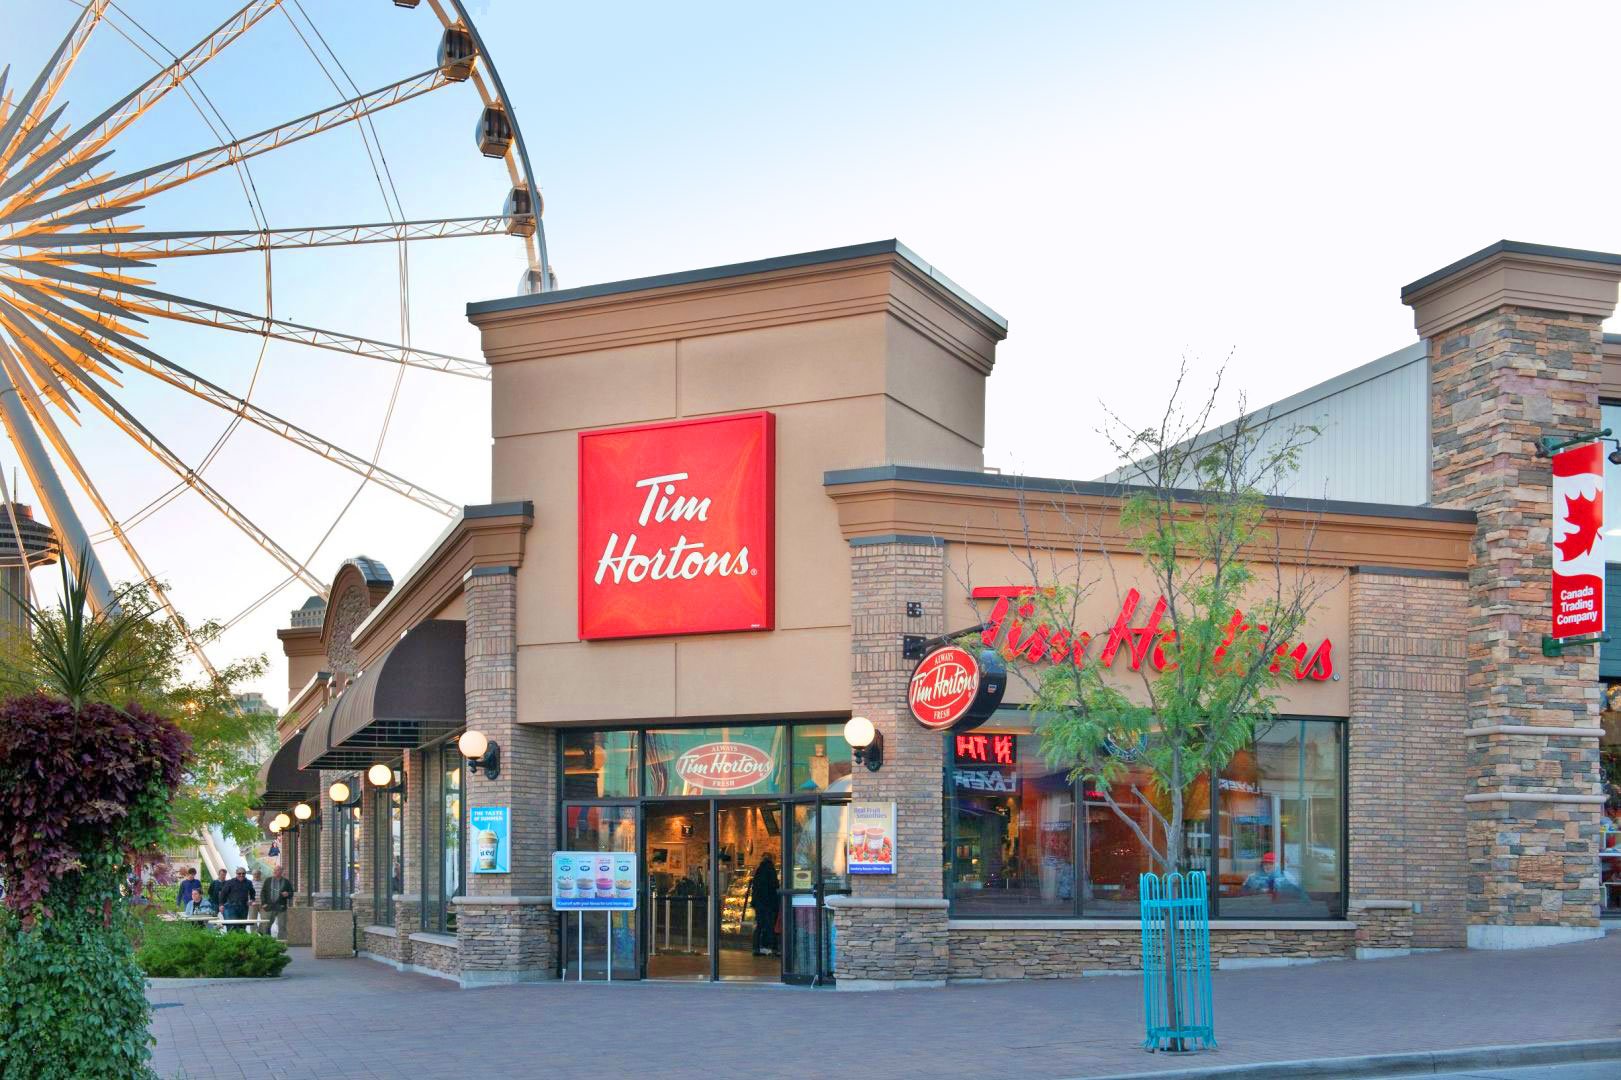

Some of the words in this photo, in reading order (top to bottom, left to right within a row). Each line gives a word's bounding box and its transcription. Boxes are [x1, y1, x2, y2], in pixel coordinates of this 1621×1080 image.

[635, 472, 712, 527] Tim
[594, 532, 749, 585] Hortons
[1560, 585, 1594, 601] Canada
[1560, 598, 1594, 612] Trading
[1556, 610, 1598, 625] Company
[934, 652, 954, 665] ALWAYS
[912, 671, 935, 705] Tim
[932, 665, 977, 700] Hortons
[933, 707, 951, 720] FRESH
[680, 754, 708, 775] Tim
[709, 753, 772, 773] Hortons
